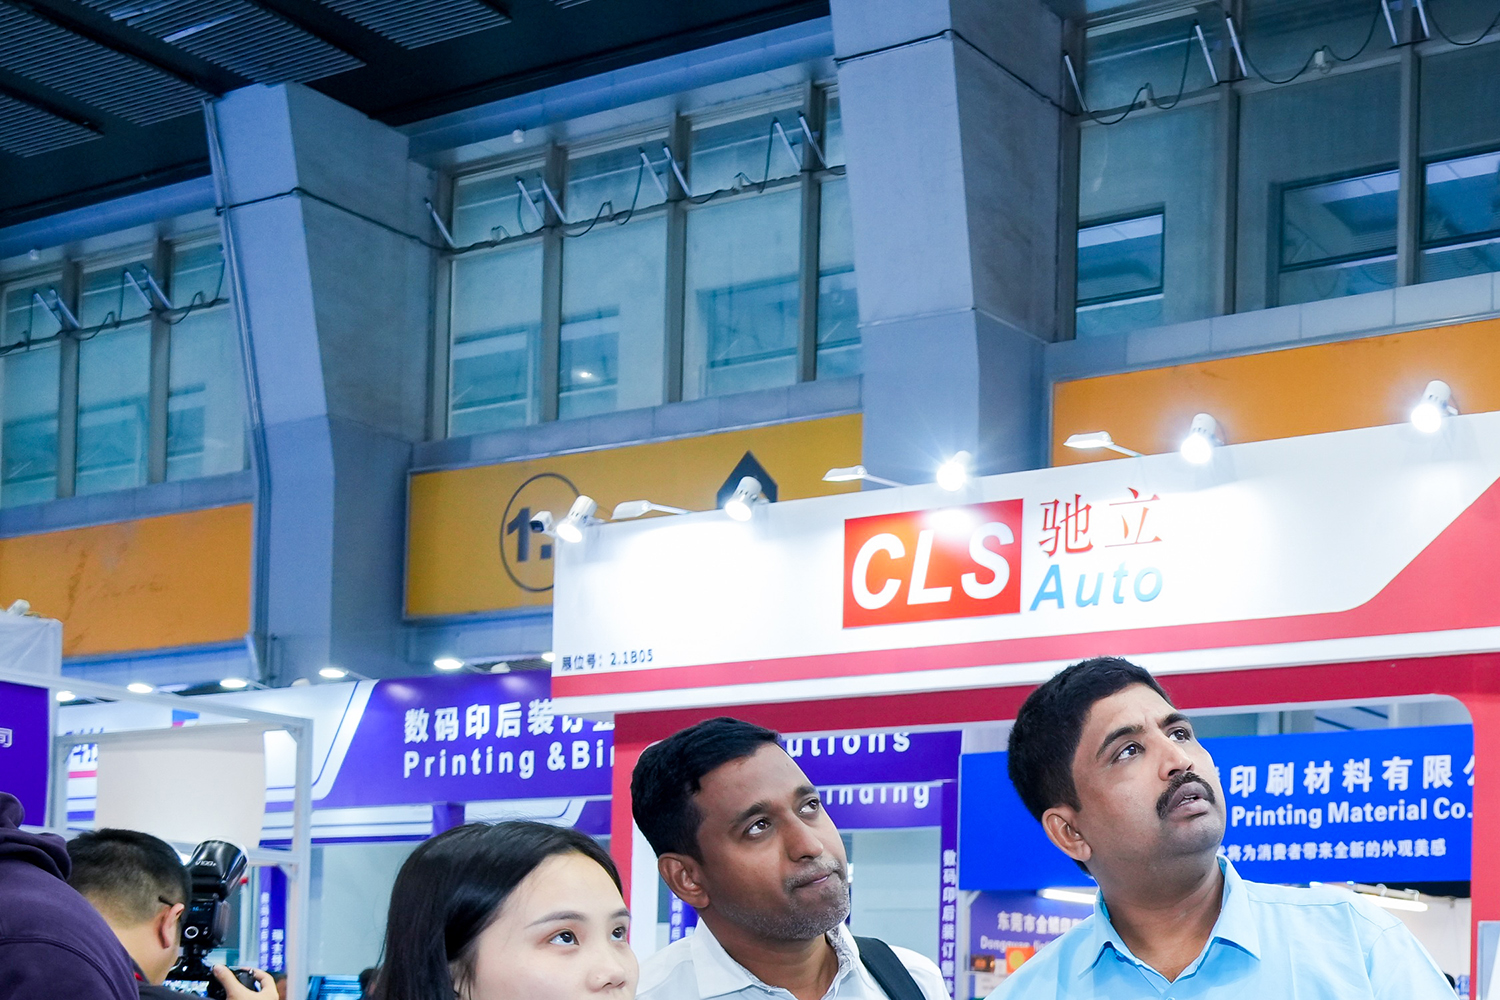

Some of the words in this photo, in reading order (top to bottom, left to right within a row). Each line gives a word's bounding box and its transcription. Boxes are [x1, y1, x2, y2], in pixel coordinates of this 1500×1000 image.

[1038, 487, 1163, 558] 驰立
[851, 521, 1015, 610] CLS
[1029, 561, 1163, 612] Auto
[403, 746, 535, 780] Printing
[547, 739, 614, 771] &Bi
[1231, 803, 1322, 829] Printing
[1328, 797, 1427, 824] Material
[1433, 796, 1473, 820] Co.
